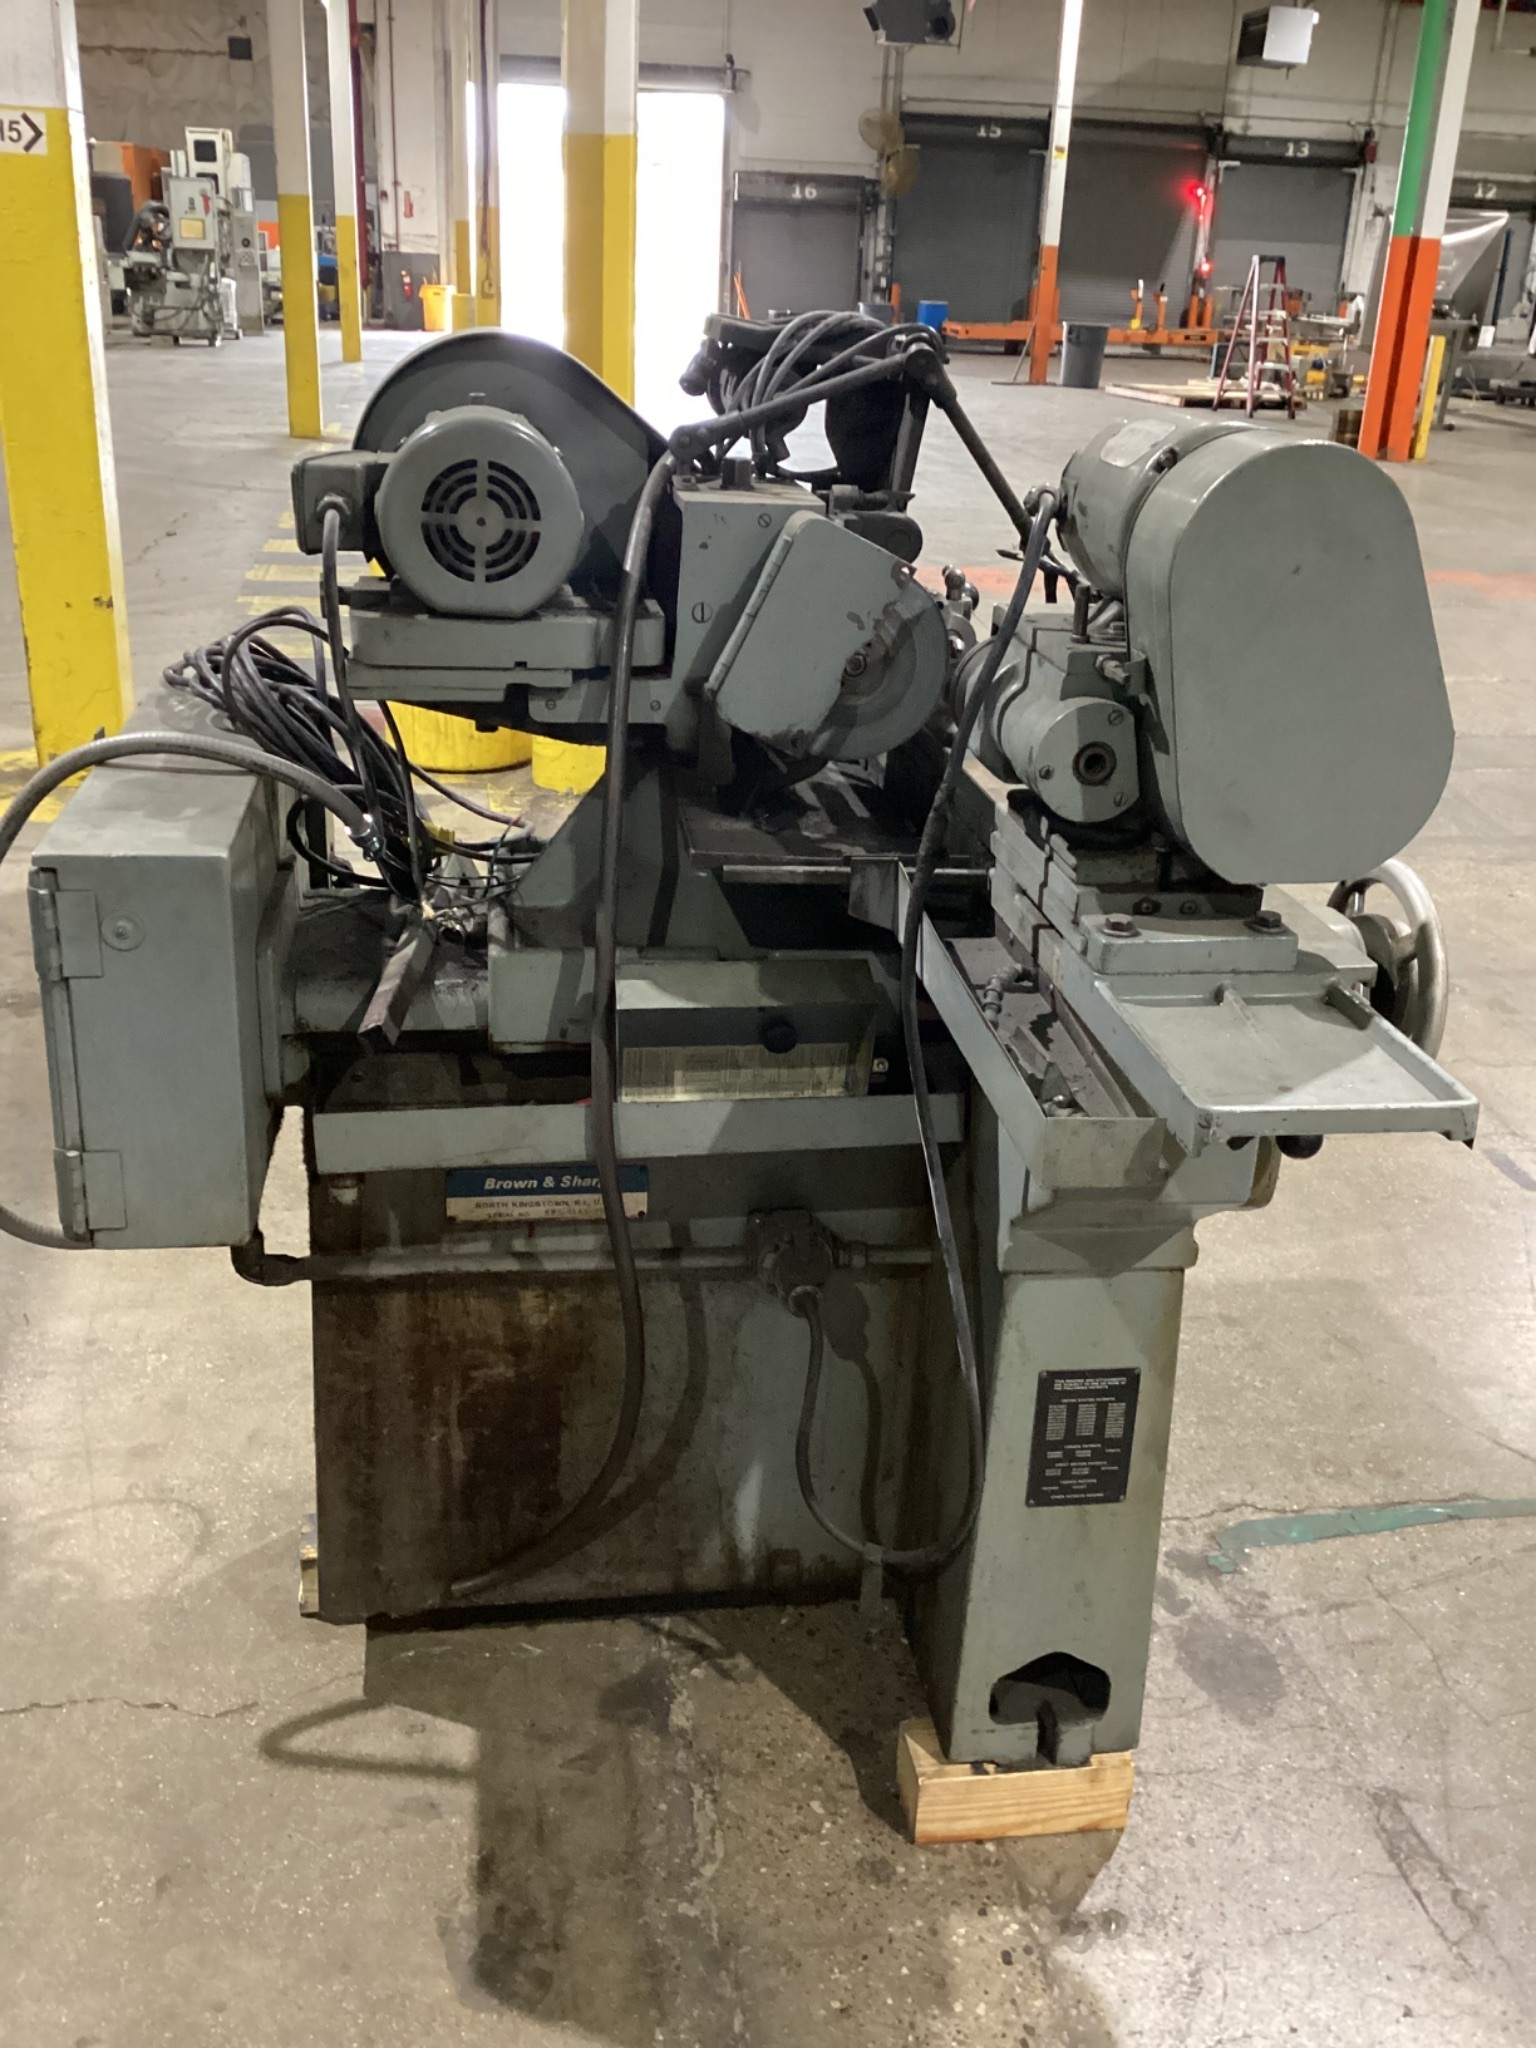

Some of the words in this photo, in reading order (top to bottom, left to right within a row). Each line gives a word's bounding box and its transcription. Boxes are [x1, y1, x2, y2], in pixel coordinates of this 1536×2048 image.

[976, 122, 1002, 138] 15
[1284, 141, 1309, 158] 13
[791, 182, 818, 200] 16
[1473, 182, 1497, 200] 12
[484, 1177, 538, 1190] Brown
[543, 1175, 555, 1188] &
[560, 1175, 600, 1188] Shar
[475, 1201, 509, 1209] NORTH
